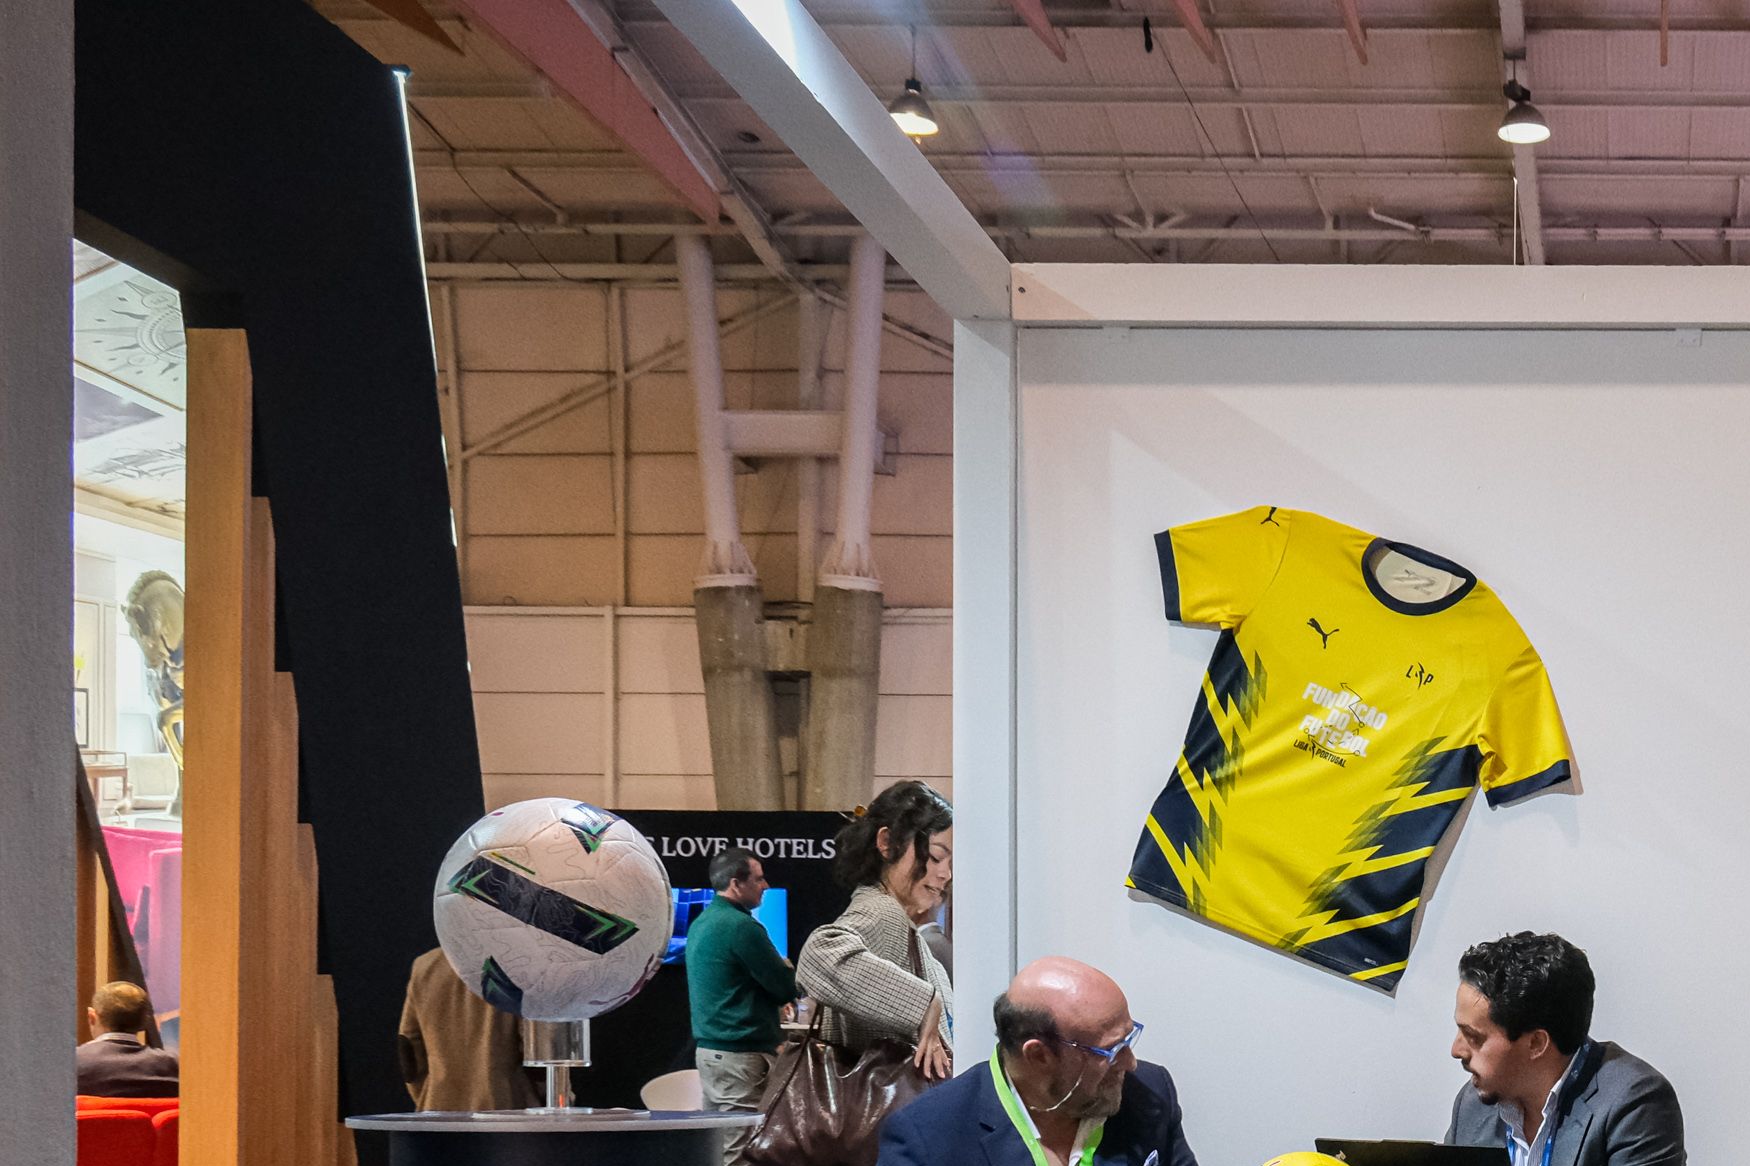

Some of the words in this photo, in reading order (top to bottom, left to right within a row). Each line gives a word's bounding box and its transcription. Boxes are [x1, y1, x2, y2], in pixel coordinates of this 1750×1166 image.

[1325, 708, 1351, 731] DO
[1294, 739, 1309, 752] LIGA
[1315, 748, 1347, 768] PORTUGAL
